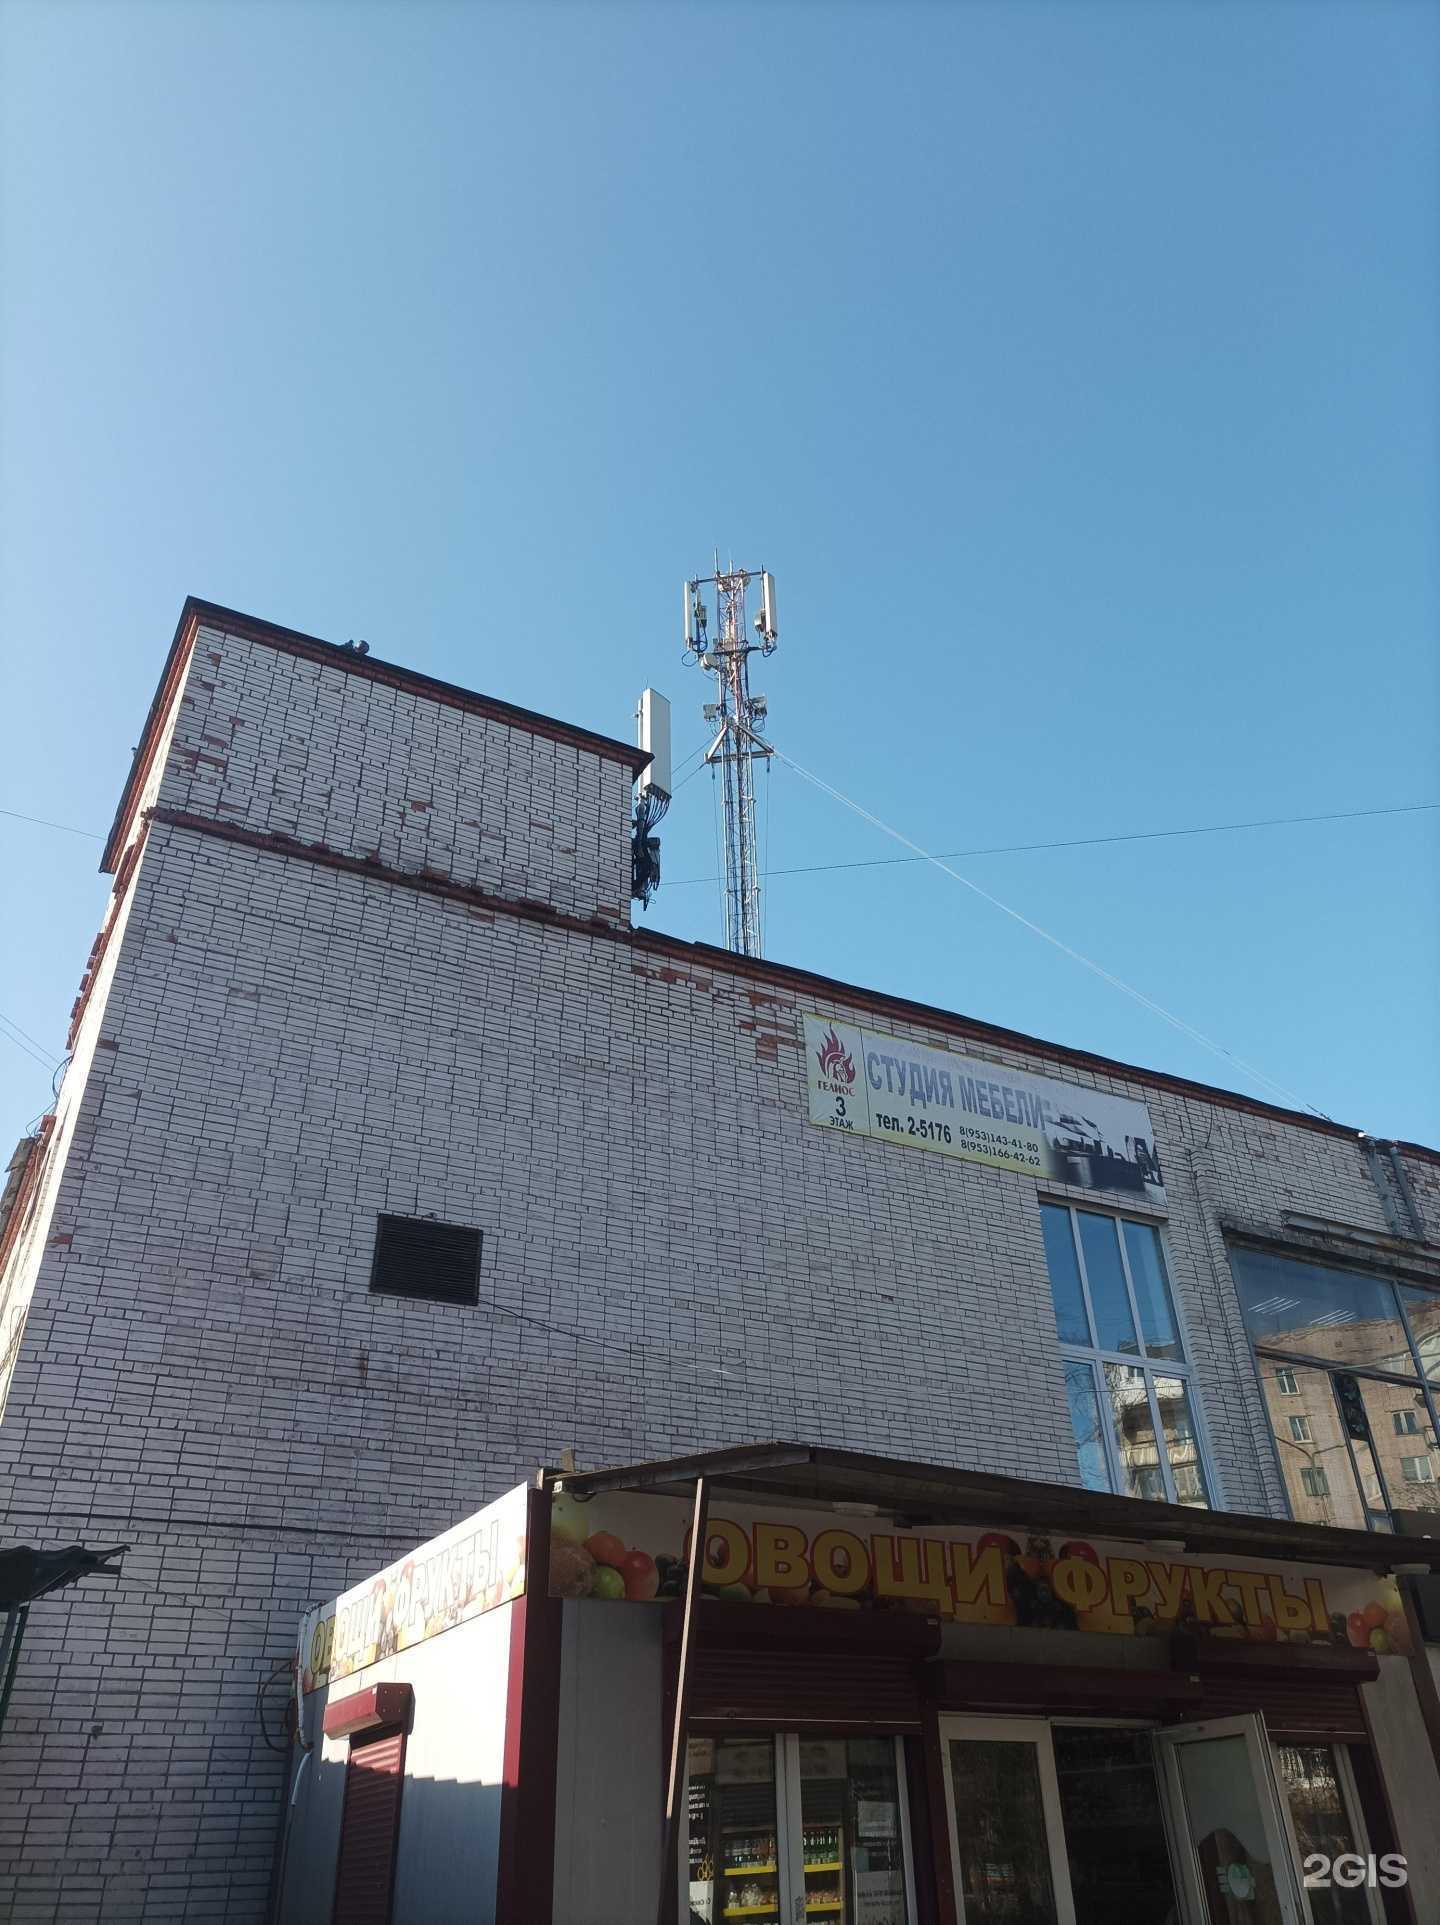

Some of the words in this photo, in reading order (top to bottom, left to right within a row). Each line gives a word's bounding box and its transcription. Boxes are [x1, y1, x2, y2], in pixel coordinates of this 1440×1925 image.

[817, 1080, 856, 1097] ГЕЛИОС
[867, 1051, 954, 1109] СТУДИЯ
[958, 1075, 1045, 1131] МЕБЕЛИ
[835, 1096, 846, 1117] 3
[829, 1116, 854, 1130] ЭТАЖ
[876, 1113, 904, 1133] тел.
[907, 1116, 952, 1144] 2-5176
[959, 1126, 1039, 1153] 8(953)143-41-80
[960, 1138, 1041, 1166] 8(953)166-42-62
[702, 1515, 1010, 1615] ОВОЩИ
[1050, 1549, 1331, 1633] ФРУКТЫ
